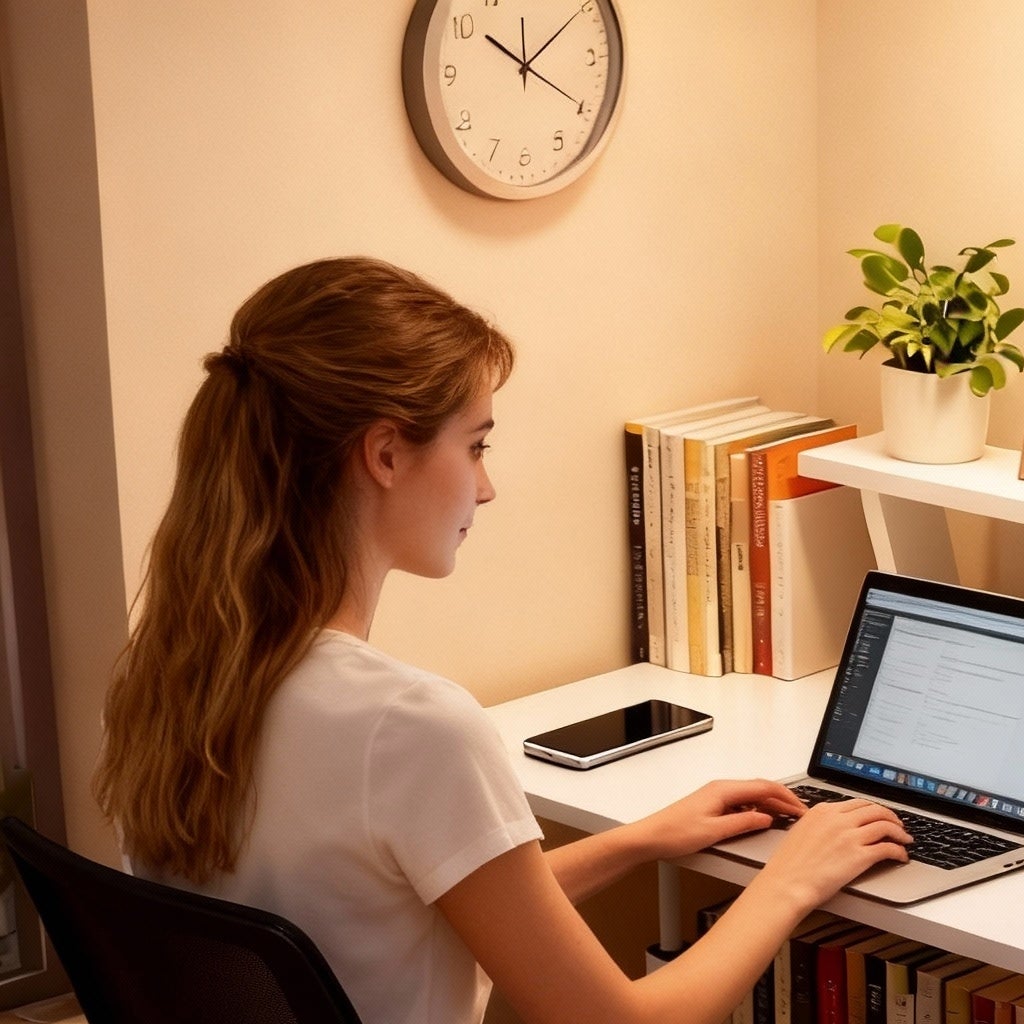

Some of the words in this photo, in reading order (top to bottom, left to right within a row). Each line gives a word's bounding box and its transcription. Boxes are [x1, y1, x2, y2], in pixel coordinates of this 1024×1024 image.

[453, 13, 475, 40] 10
[443, 64, 457, 87] 9
[488, 138, 501, 163] 7
[552, 130, 564, 152] 5
[518, 147, 532, 167] 6
